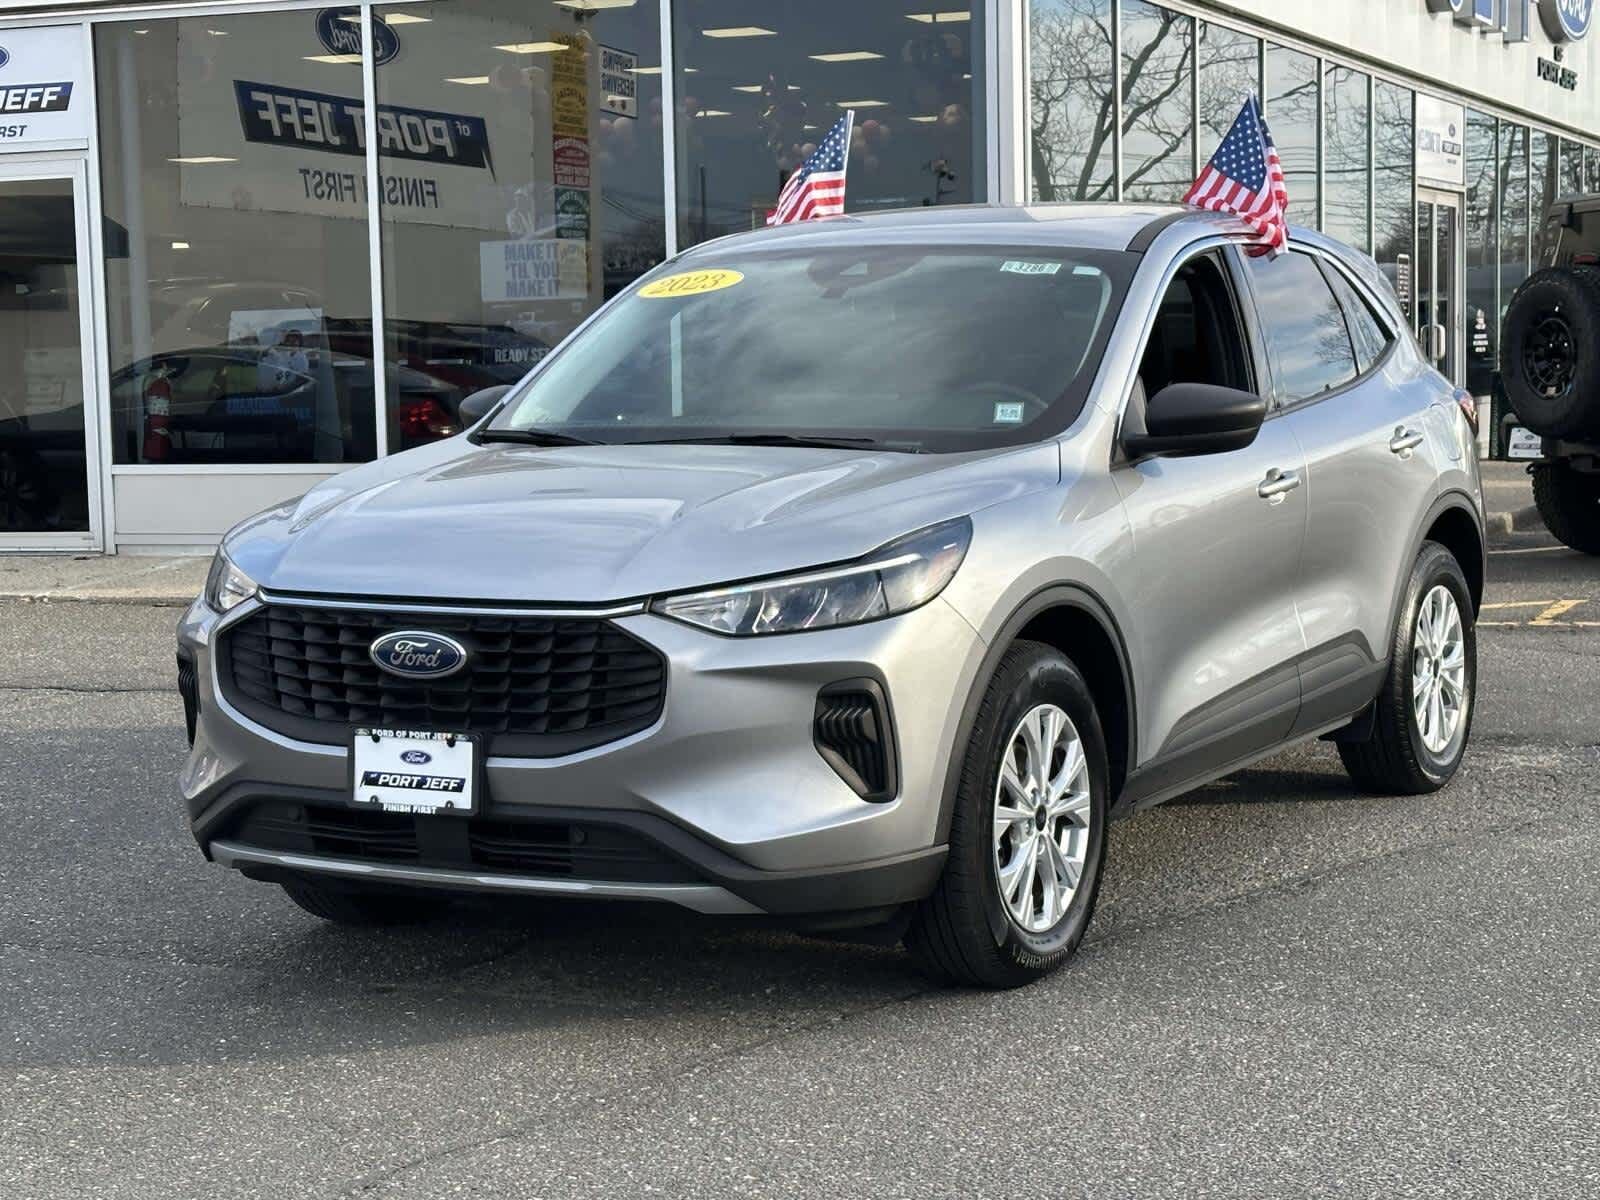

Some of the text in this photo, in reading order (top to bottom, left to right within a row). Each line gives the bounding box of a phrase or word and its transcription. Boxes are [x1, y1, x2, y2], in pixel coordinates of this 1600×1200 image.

[1537, 56, 1560, 84] PORT
[504, 242, 559, 260] MAKE IT
[533, 261, 559, 279] YOU
[506, 279, 560, 297] MAKE IT
[648, 273, 726, 294] 2023
[390, 640, 441, 667] Ford
[371, 729, 394, 737] FORD
[396, 730, 407, 738] OF
[409, 731, 431, 740] PORT
[433, 732, 452, 741] JEFF
[405, 752, 427, 763] Ford
[378, 774, 421, 788] PORT
[422, 777, 461, 791] JEFF
[413, 805, 438, 815] FIRST
